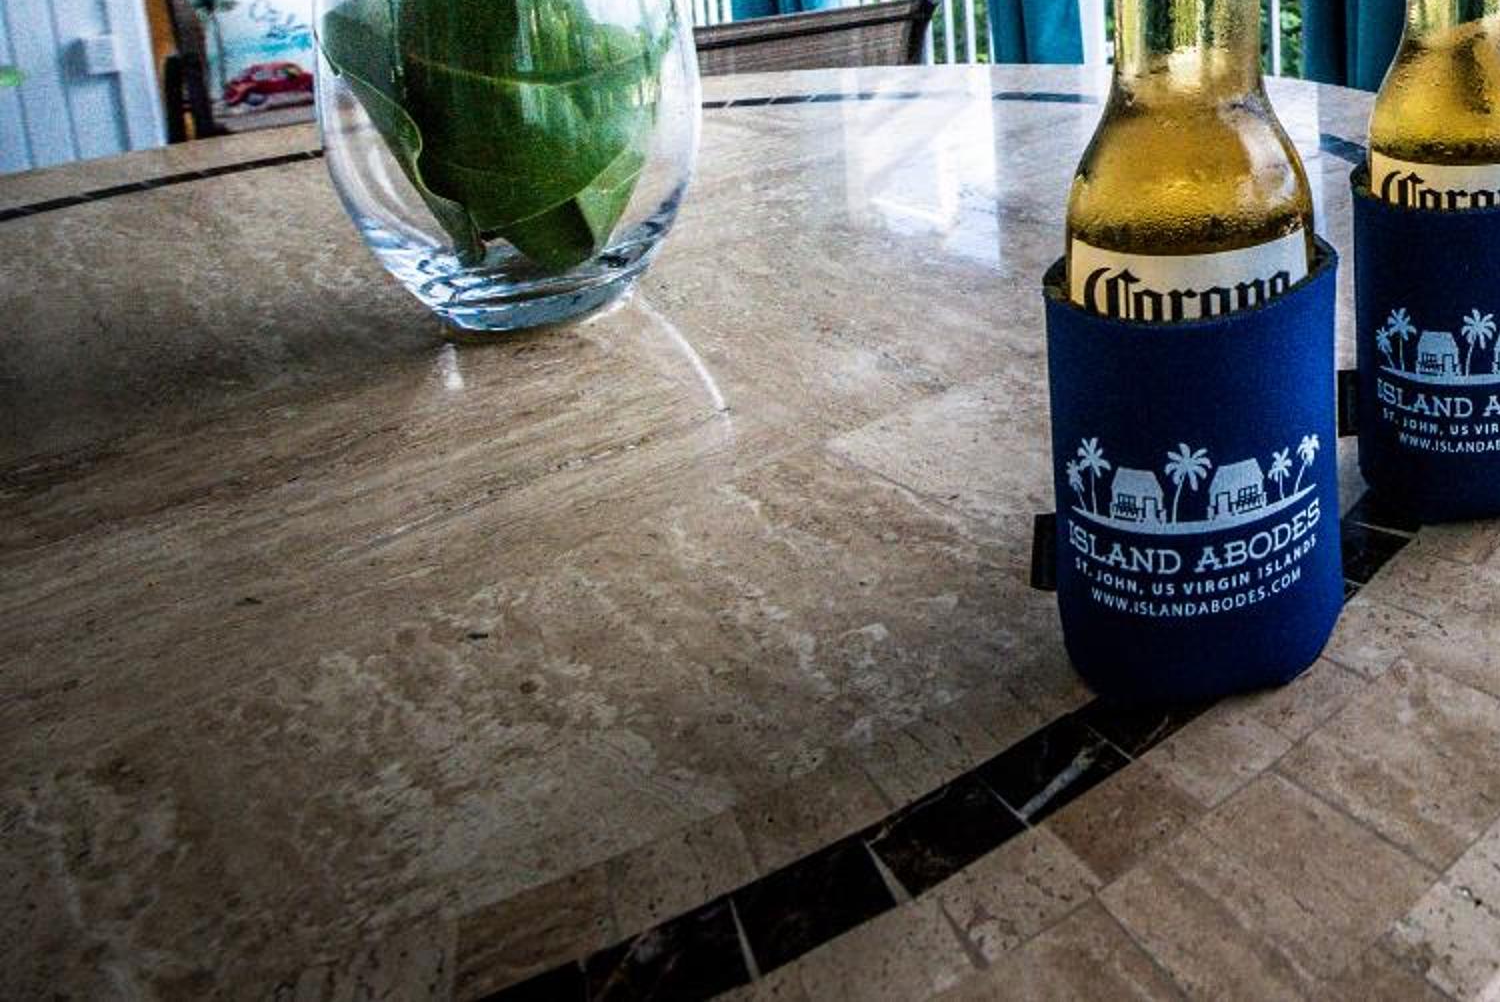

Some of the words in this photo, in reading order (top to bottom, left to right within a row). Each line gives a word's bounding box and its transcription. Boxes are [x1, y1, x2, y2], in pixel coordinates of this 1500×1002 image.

[1377, 378, 1473, 418] ISLAND
[1402, 419, 1445, 436] JOHN,
[1450, 425, 1470, 436] US
[1067, 520, 1182, 575] ISLAND
[1195, 499, 1321, 573] ABODES
[1075, 557, 1093, 577] ST.
[1095, 571, 1144, 595] JOHN,
[1151, 584, 1176, 596] US
[1183, 572, 1251, 596] VIRGIN
[1257, 534, 1318, 578] ISLANDS
[1091, 566, 1302, 617] WWW.ISLANDABODES.COM
